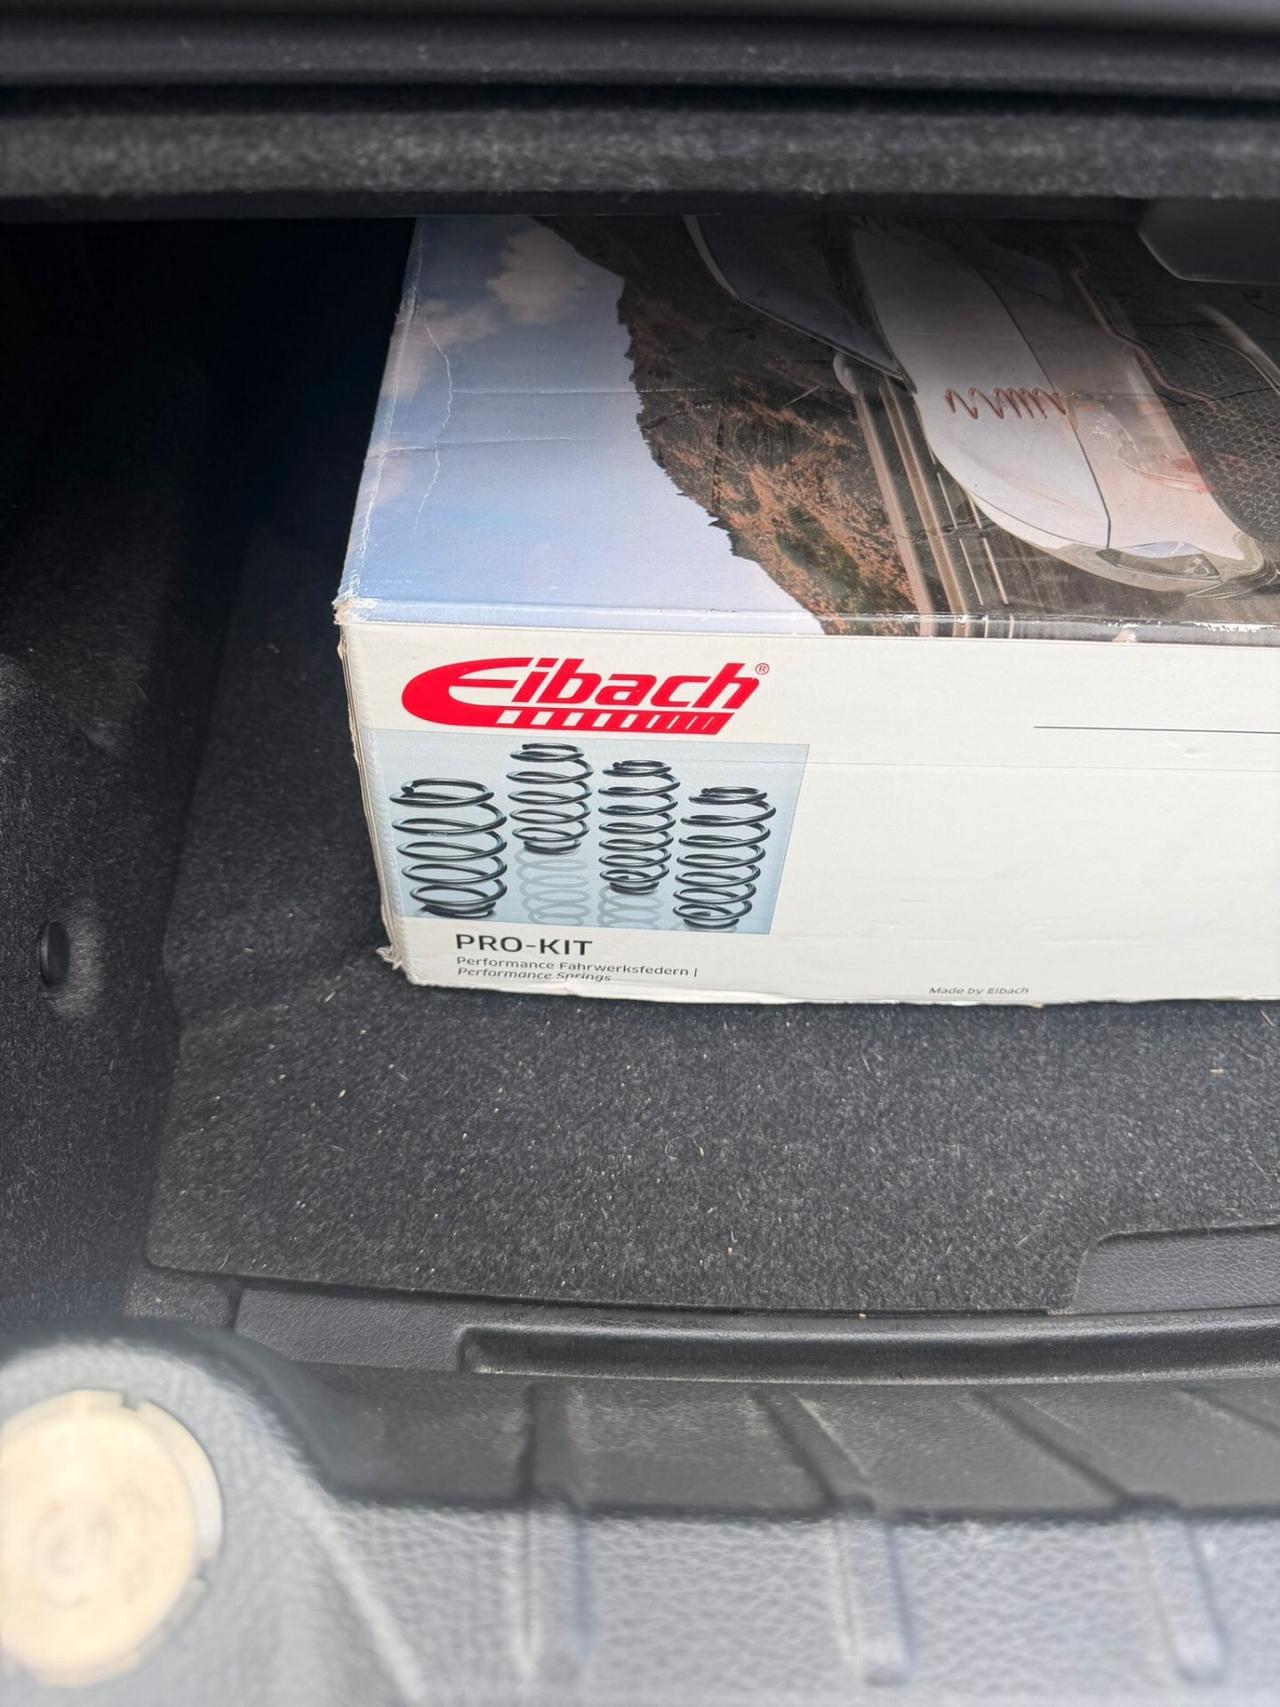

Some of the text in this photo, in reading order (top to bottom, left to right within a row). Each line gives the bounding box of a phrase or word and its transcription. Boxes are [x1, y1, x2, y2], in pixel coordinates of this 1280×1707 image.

[456, 933, 592, 956] PRO-KIT
[456, 956, 555, 970] Performance
[559, 961, 689, 976] Fahrwerksfedern
[457, 966, 612, 983] Performance Springs
[928, 986, 1029, 996] Made by Eibach
